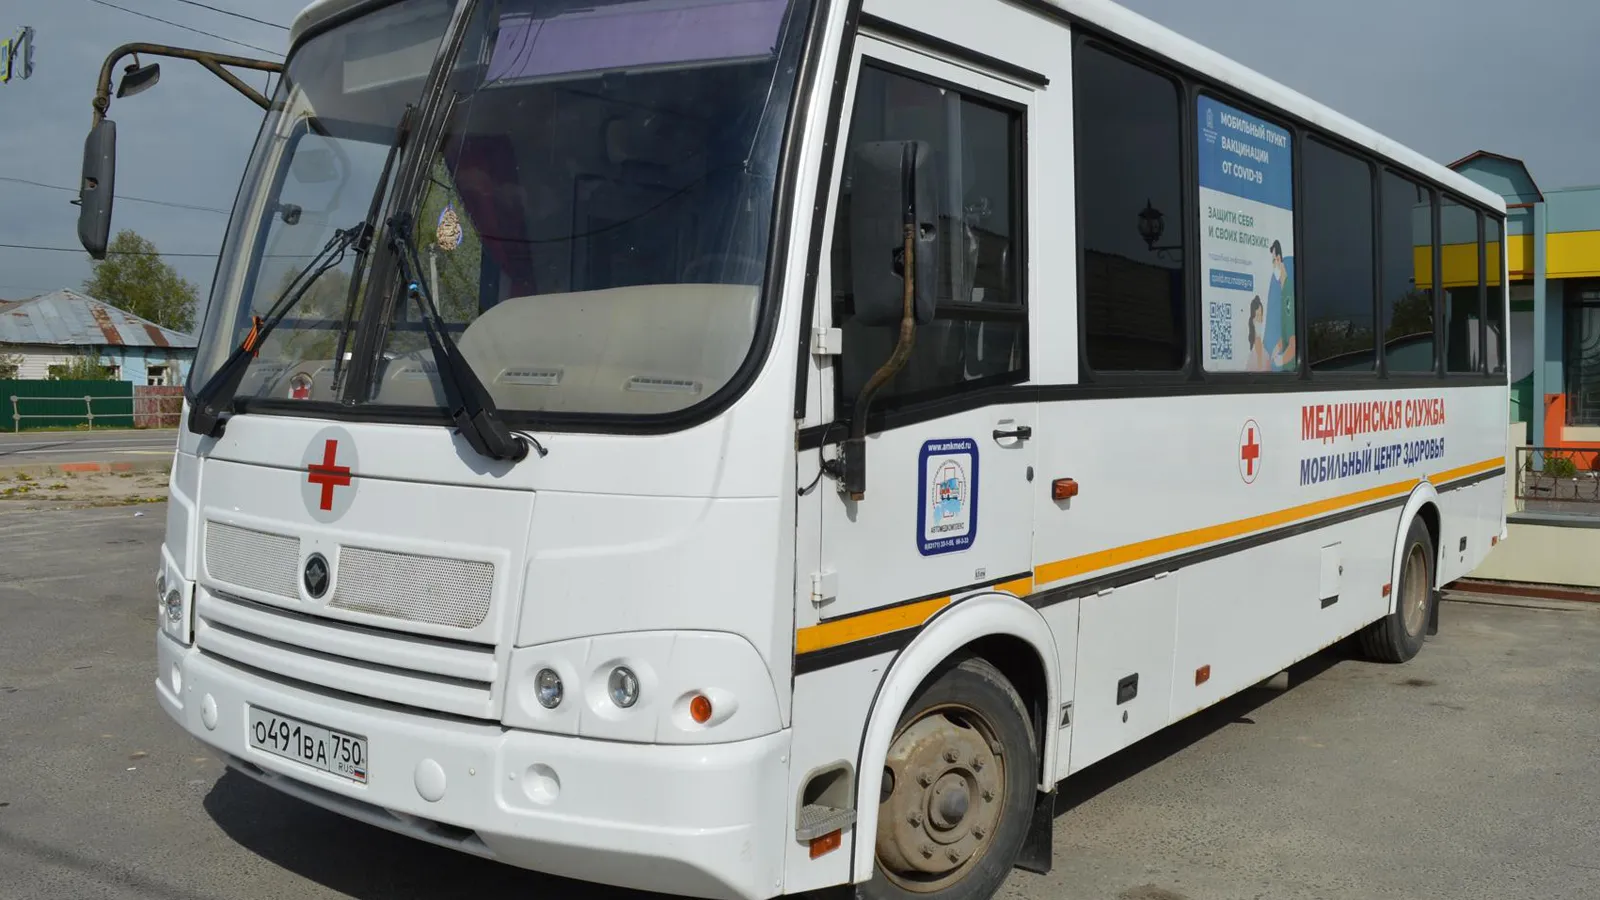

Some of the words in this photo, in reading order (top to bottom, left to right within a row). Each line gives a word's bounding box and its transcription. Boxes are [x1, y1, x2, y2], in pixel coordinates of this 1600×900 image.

[1220, 112, 1265, 140] МОБИЛЬНЫЙ
[1266, 130, 1287, 148] ПУНКТ
[1221, 135, 1269, 164] ВАКЦИНАЦИИ
[1222, 161, 1232, 175] ОТ
[1233, 164, 1263, 184] COVID-19
[1208, 206, 1237, 224] ЗАЩИТИ
[1238, 214, 1254, 228] СЕБЯ
[1208, 225, 1214, 238] И
[1215, 227, 1238, 243] СВОИХ
[1302, 400, 1402, 445] МЕДИЦИНСКАЯ
[1405, 398, 1445, 428] СЛУЖБА
[928, 441, 972, 451] www.amkmed.ru
[1300, 441, 1372, 486] МОБИЛЬНЫЙ
[1374, 444, 1401, 474] ЦЕНТР
[1403, 437, 1445, 468] ЗДОРОВЬЯ
[332, 734, 362, 766] 750
[338, 762, 354, 775] RUS
